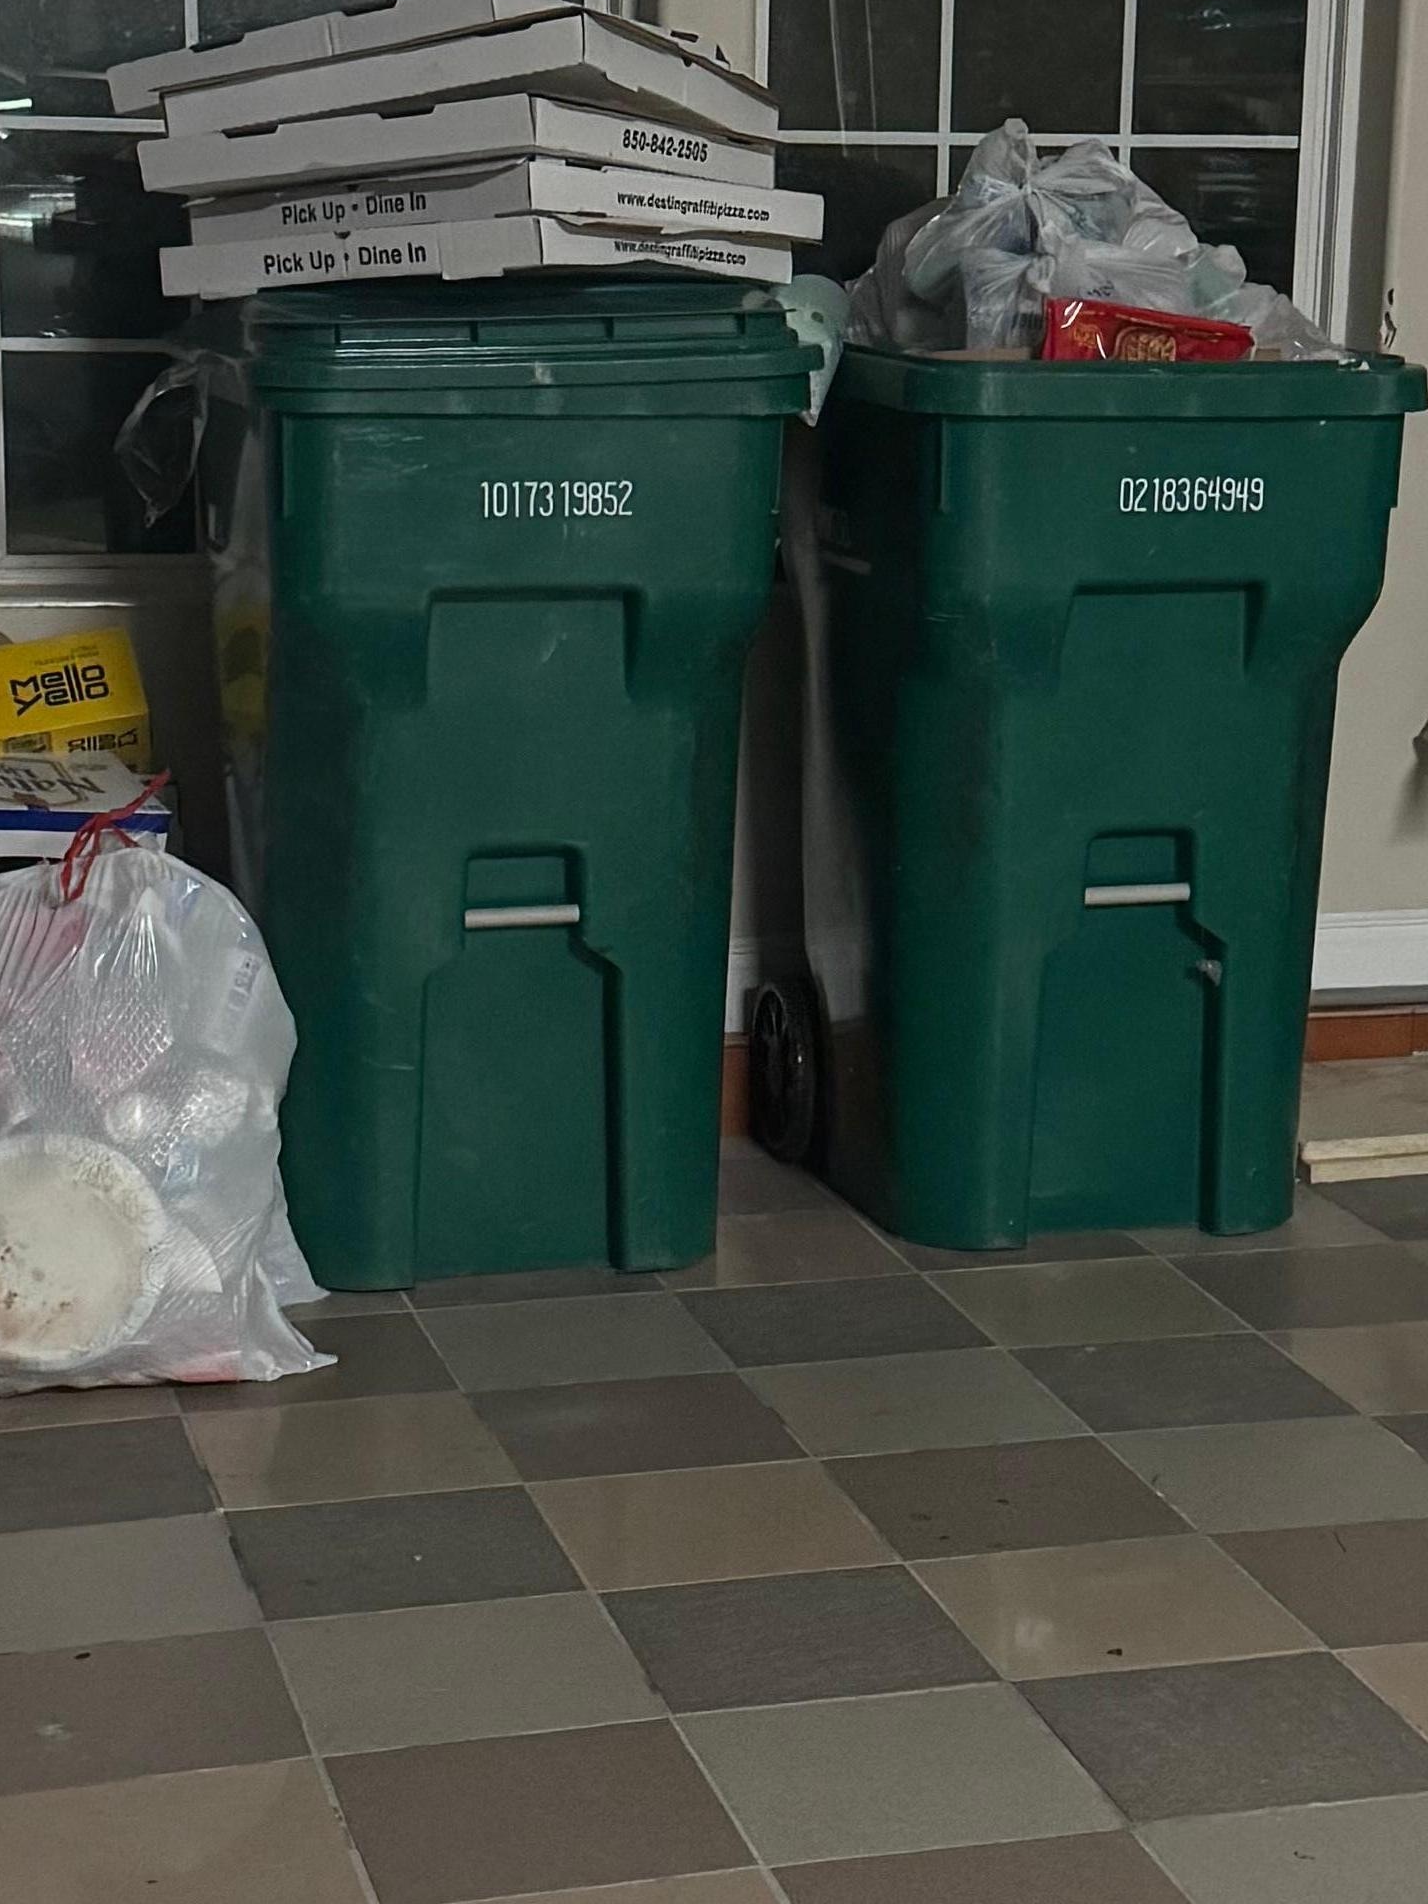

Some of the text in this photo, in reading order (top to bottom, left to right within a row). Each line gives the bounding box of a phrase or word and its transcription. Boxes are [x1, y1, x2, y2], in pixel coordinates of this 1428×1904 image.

[622, 129, 709, 163] 850-842-2505
[281, 191, 427, 225] Pick Up Dine In
[617, 192, 770, 222] www.destingraffitipizza.com
[263, 242, 427, 275] Pick Up Dine In
[480, 480, 633, 518] 1017319852
[1120, 476, 1264, 513] 0218364949
